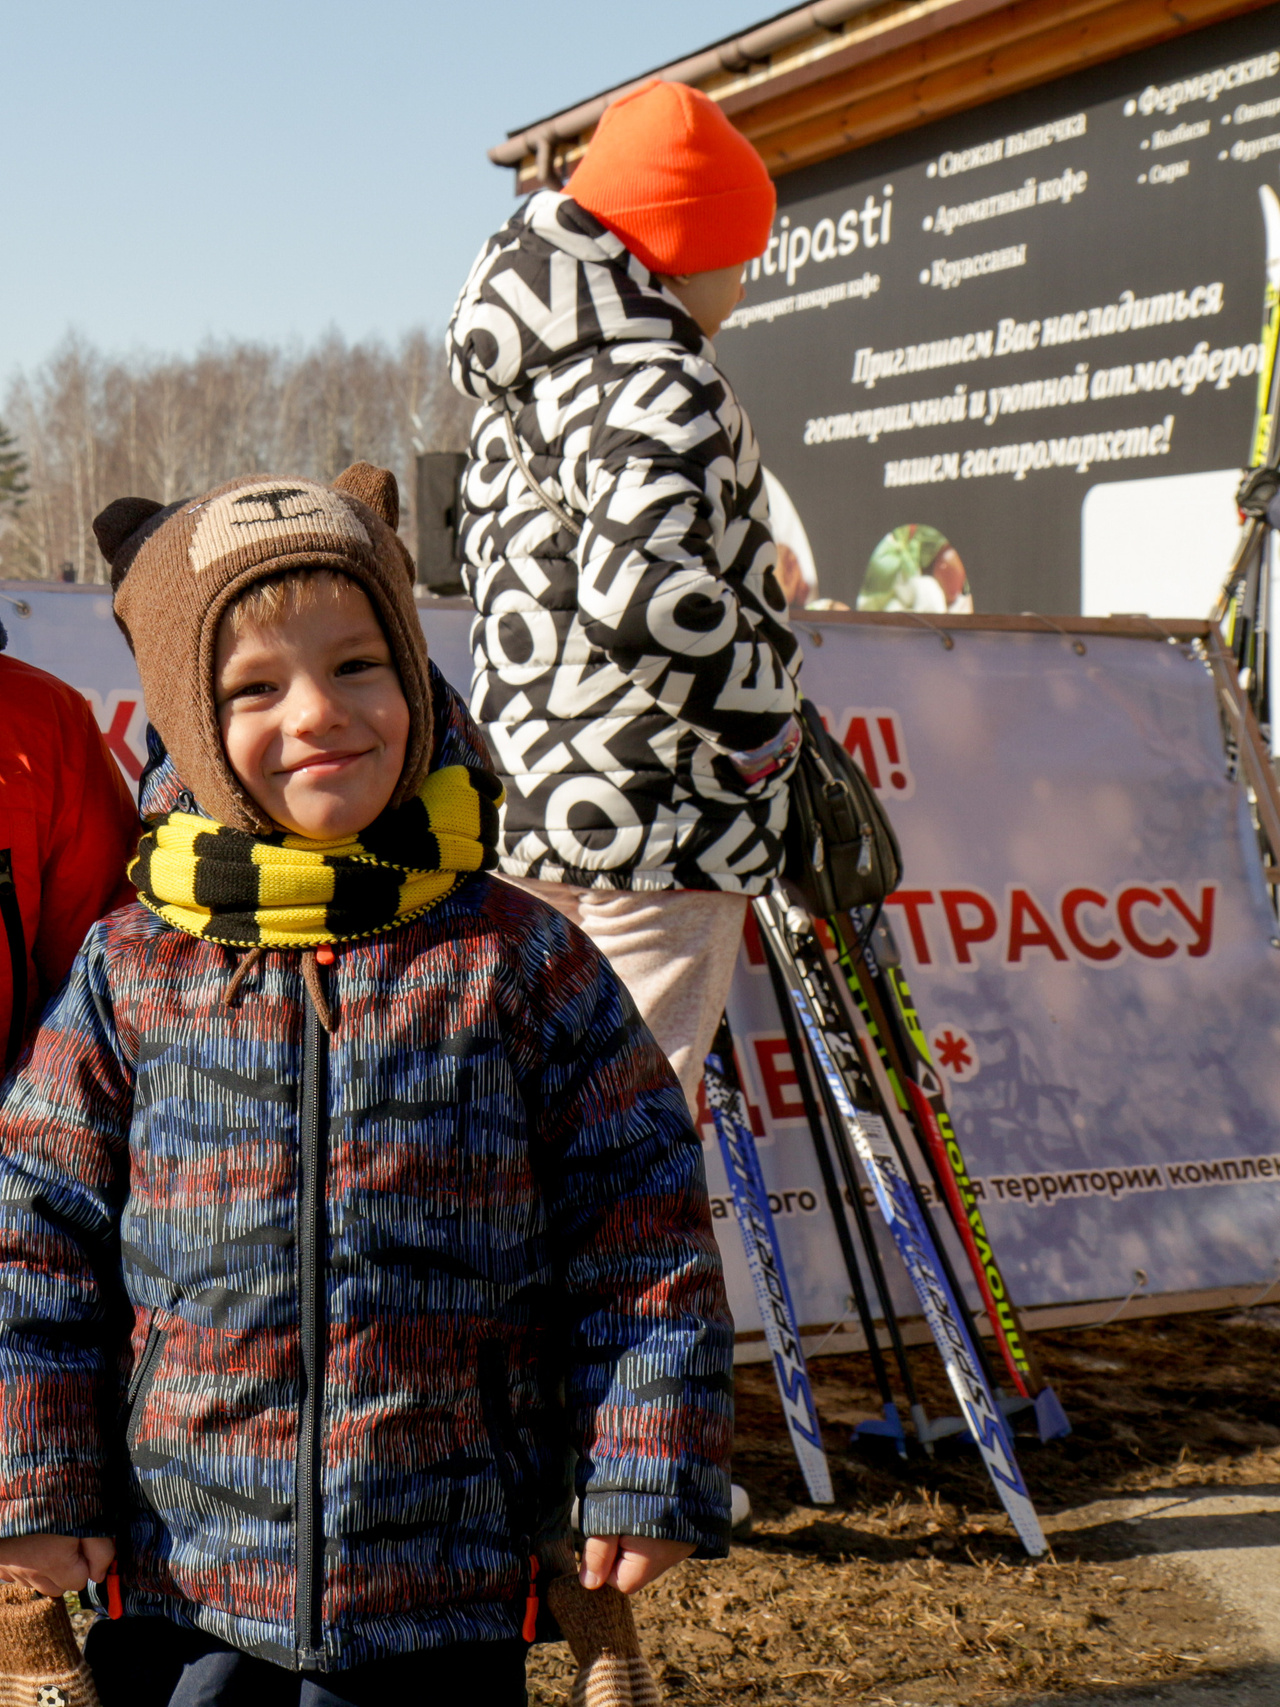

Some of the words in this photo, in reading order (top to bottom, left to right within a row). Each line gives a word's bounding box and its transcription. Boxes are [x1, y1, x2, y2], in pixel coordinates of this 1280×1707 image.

[1138, 51, 1280, 116] Фермерские
[1233, 97, 1280, 125] Овощ
[938, 139, 1005, 177] Свежая
[1005, 113, 1087, 158] выпечка
[1230, 132, 1280, 162] Фрукт
[933, 177, 1037, 235] Ароматный
[1038, 168, 1088, 203] кофе
[741, 184, 893, 286] ntipasti
[931, 243, 1027, 289] Круассаны
[851, 325, 993, 389] Приглашаем
[994, 317, 1041, 356] Вас
[1041, 281, 1224, 347] насладиться
[804, 384, 968, 445] гостеприимной
[968, 389, 987, 420] и
[984, 363, 1090, 425] уютной
[883, 450, 960, 488] нашем
[961, 414, 1175, 480] гастромаркете!
[883, 886, 1216, 965] ТРАССУ
[991, 1166, 1163, 1203] территории
